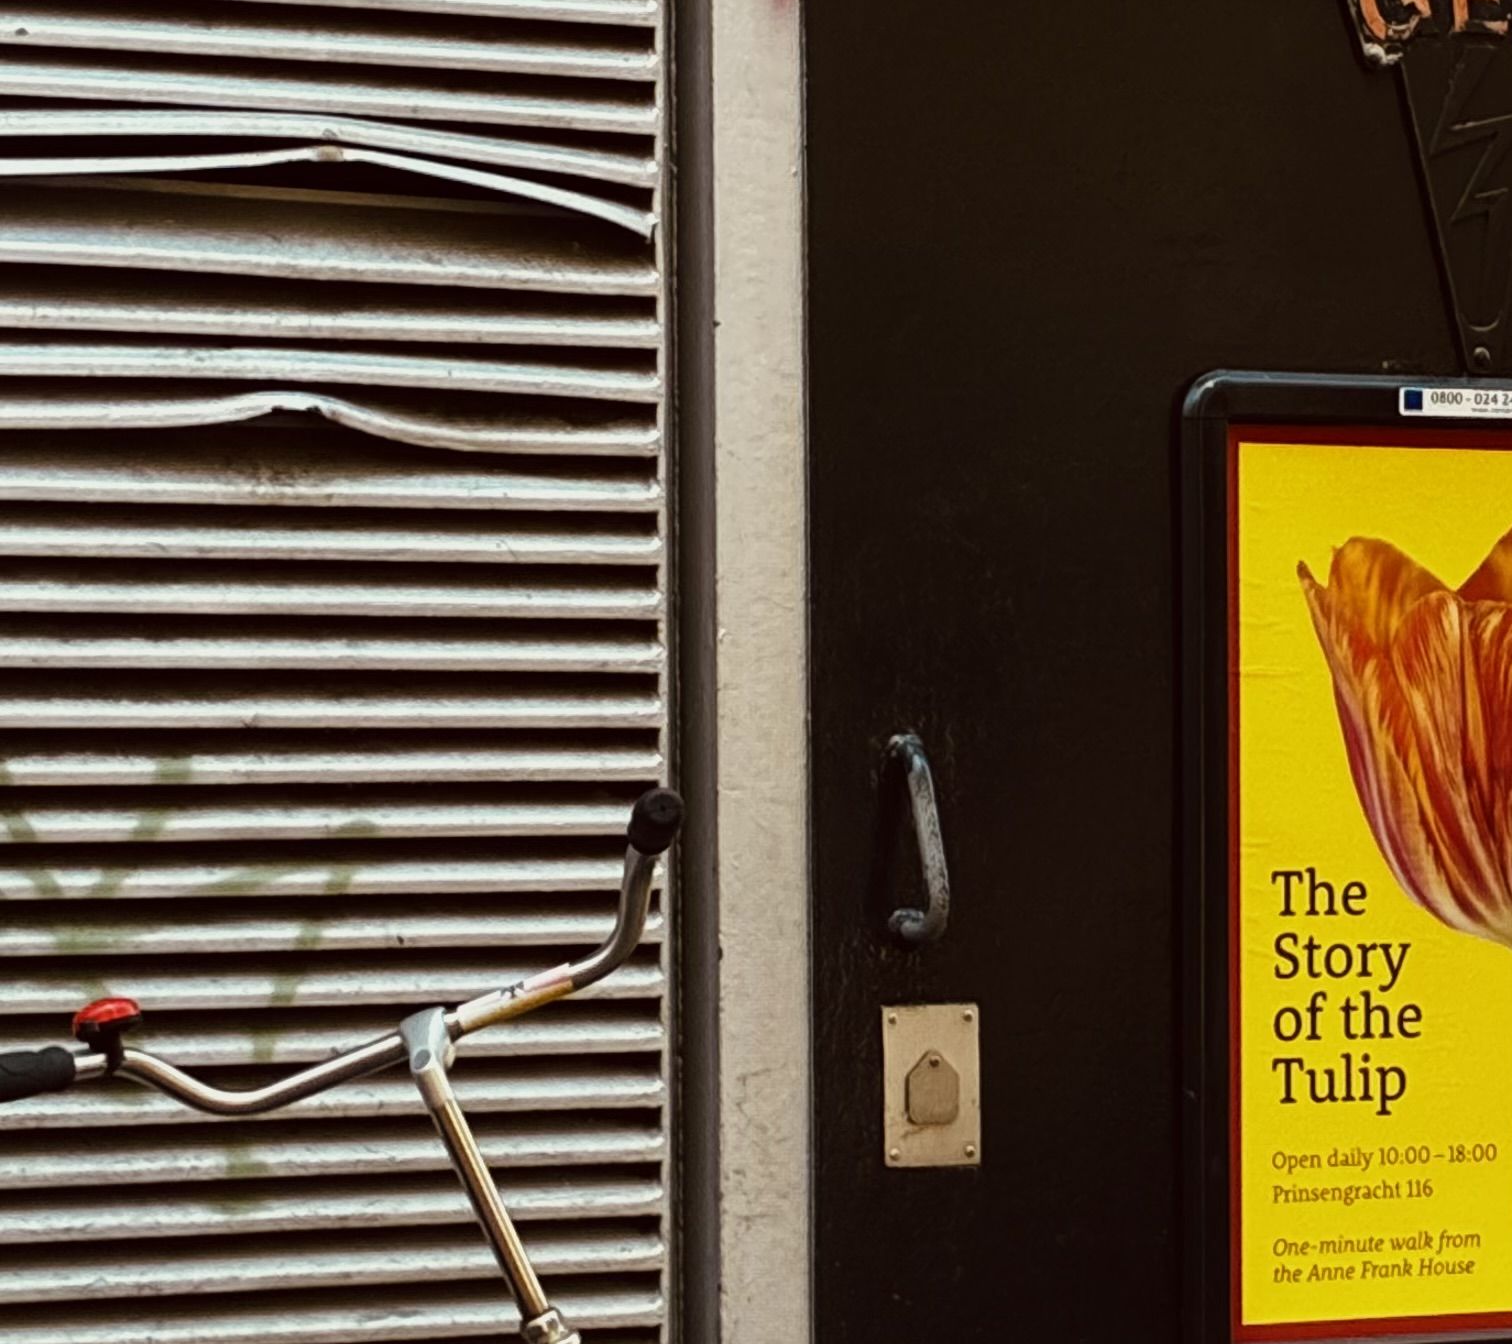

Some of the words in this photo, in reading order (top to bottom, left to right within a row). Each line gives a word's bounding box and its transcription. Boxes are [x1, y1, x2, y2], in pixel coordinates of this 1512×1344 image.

[1430, 391, 1464, 406] 0800
[1474, 393, 1499, 406] 024
[1271, 867, 1367, 916] The
[1274, 932, 1411, 992] Story
[1273, 991, 1327, 1041] of
[1340, 990, 1422, 1039] the
[1272, 1052, 1406, 1116] Tulip
[1272, 1151, 1322, 1174] Open
[1327, 1148, 1373, 1172] daily
[1272, 1180, 1402, 1206] Prinsengracht
[1406, 1179, 1434, 1198] 116
[1272, 1235, 1385, 1257] One-minute
[1390, 1231, 1433, 1251] walk
[1435, 1229, 1481, 1255] from
[1273, 1264, 1303, 1283] the
[1306, 1264, 1355, 1281] Anne
[1360, 1259, 1413, 1279] Frank
[1417, 1258, 1476, 1276] House
